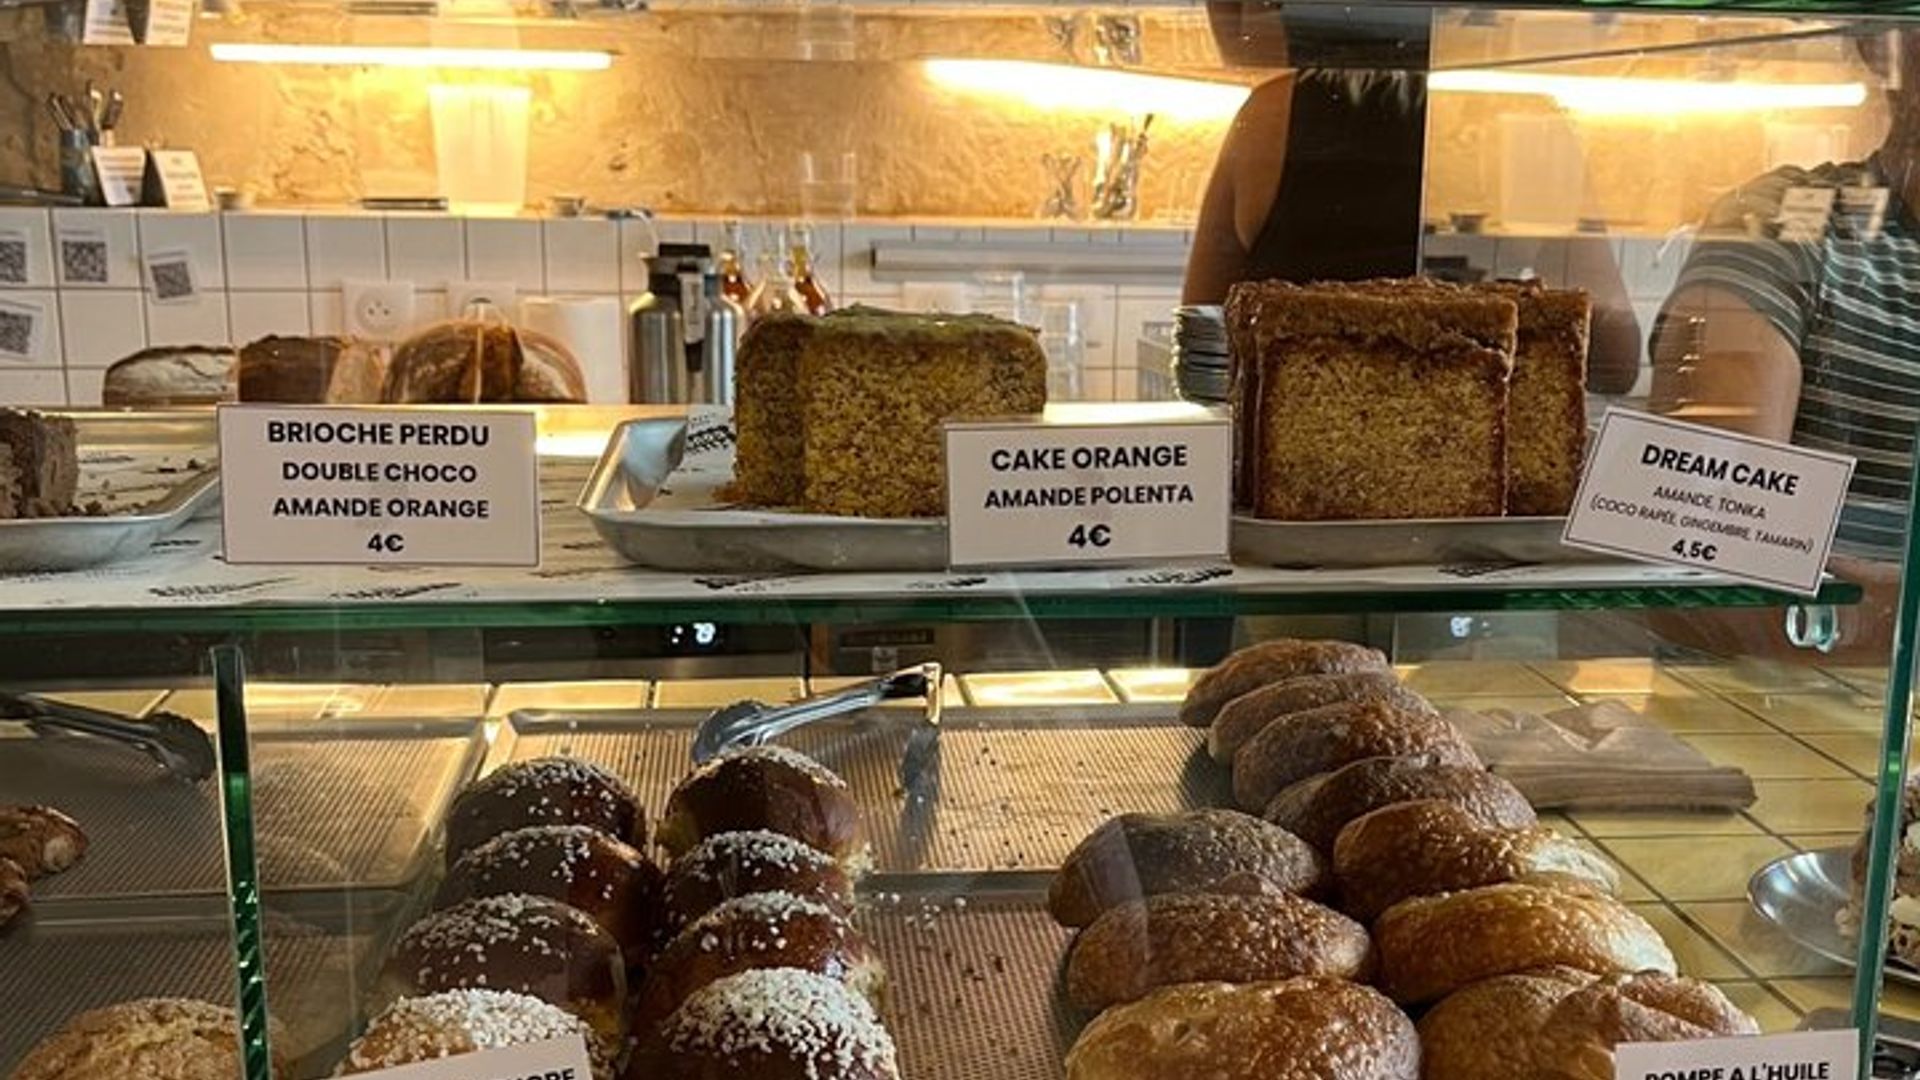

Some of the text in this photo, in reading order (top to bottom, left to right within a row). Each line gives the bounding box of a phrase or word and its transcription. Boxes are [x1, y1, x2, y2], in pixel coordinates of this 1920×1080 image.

[267, 421, 489, 446] BRIOCHE PERDU
[991, 445, 1188, 472] CAKE ORANGE
[1641, 443, 1799, 496] DREAM CAKE
[282, 461, 478, 483] DOUBLE CHOCO
[272, 497, 489, 519] AMANDE ORANGE
[984, 484, 1194, 509] AMANDE POLENTA
[1590, 493, 1638, 517] (COCO
[1719, 497, 1766, 520] TONKA
[367, 533, 404, 553] 4€
[1068, 523, 1111, 548] 4€
[1729, 1066, 1745, 1080] A
[1751, 1062, 1830, 1080] L'HUILE
